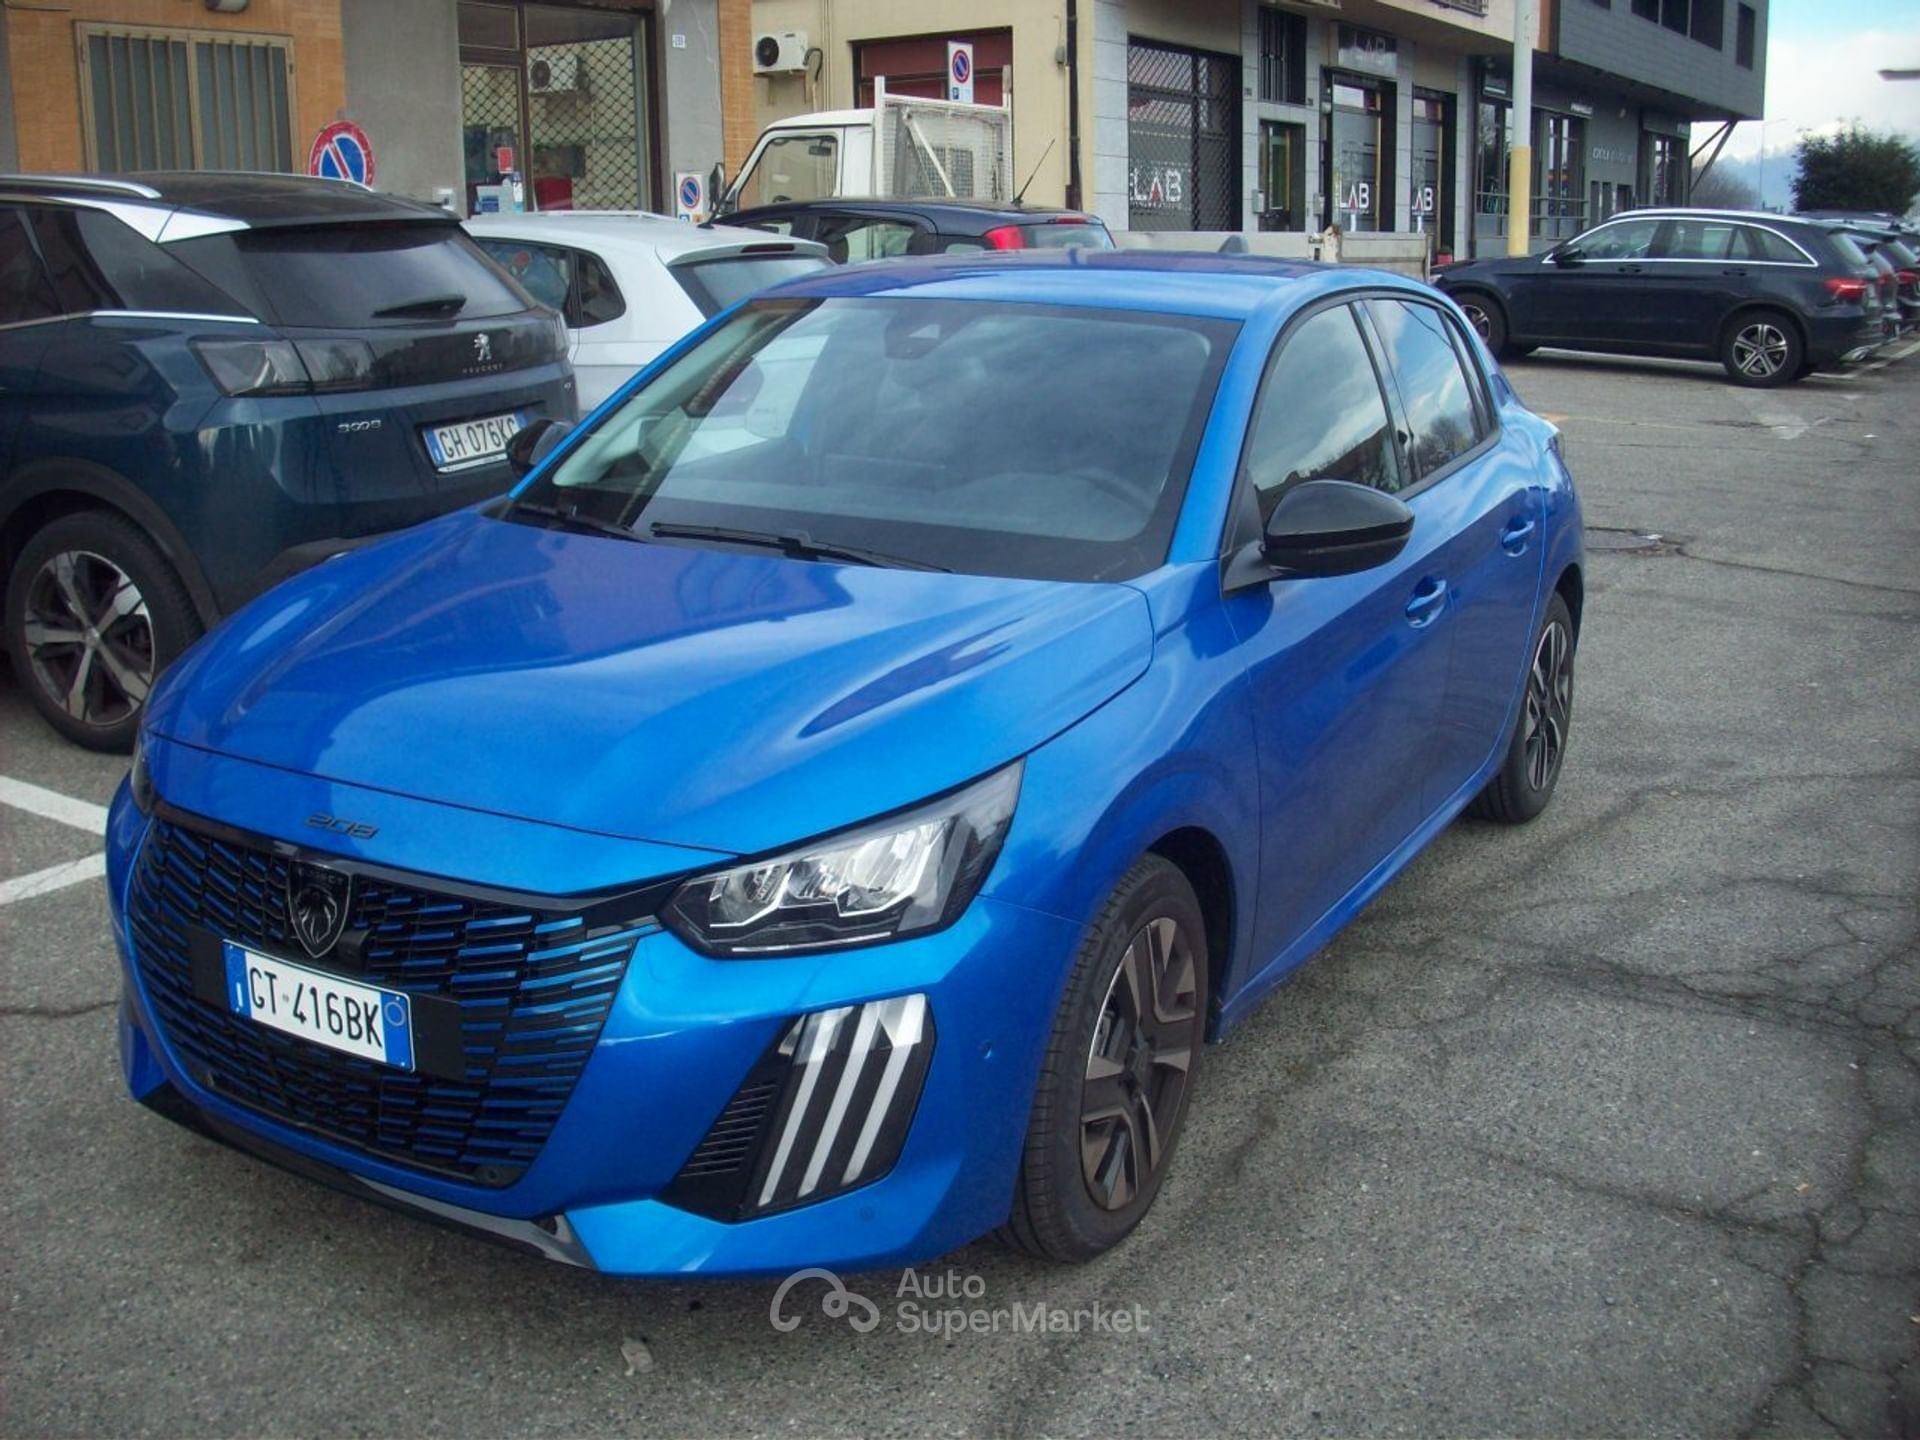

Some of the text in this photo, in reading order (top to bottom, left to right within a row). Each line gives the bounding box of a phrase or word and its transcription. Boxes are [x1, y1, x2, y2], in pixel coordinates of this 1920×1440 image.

[1134, 167, 1181, 202] LAB
[1340, 175, 1369, 209] LAB
[304, 813, 380, 840] 208
[293, 982, 383, 1048] 416BK
